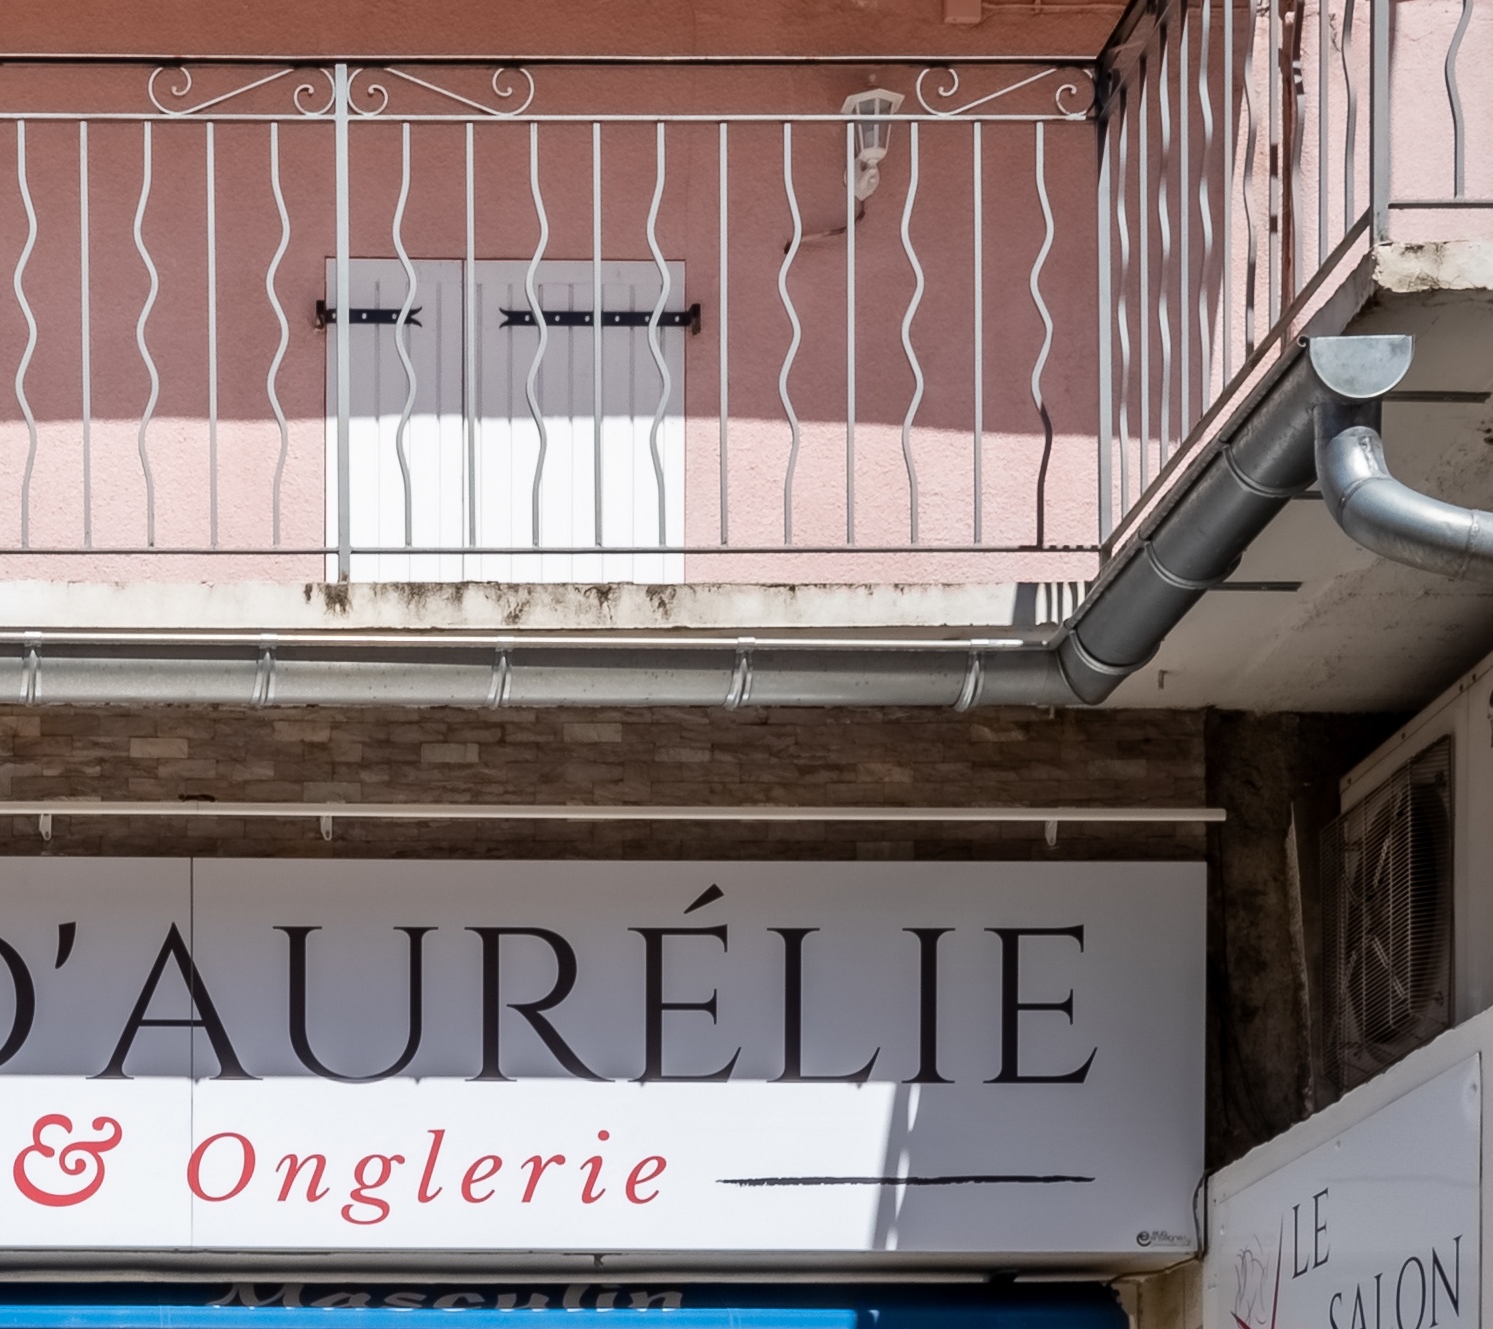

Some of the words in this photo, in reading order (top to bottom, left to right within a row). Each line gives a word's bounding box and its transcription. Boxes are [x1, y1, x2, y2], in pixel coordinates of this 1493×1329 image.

[12, 1113, 123, 1207] &
[186, 1129, 667, 1225] Onglerie
[1292, 1188, 1330, 1280] LE
